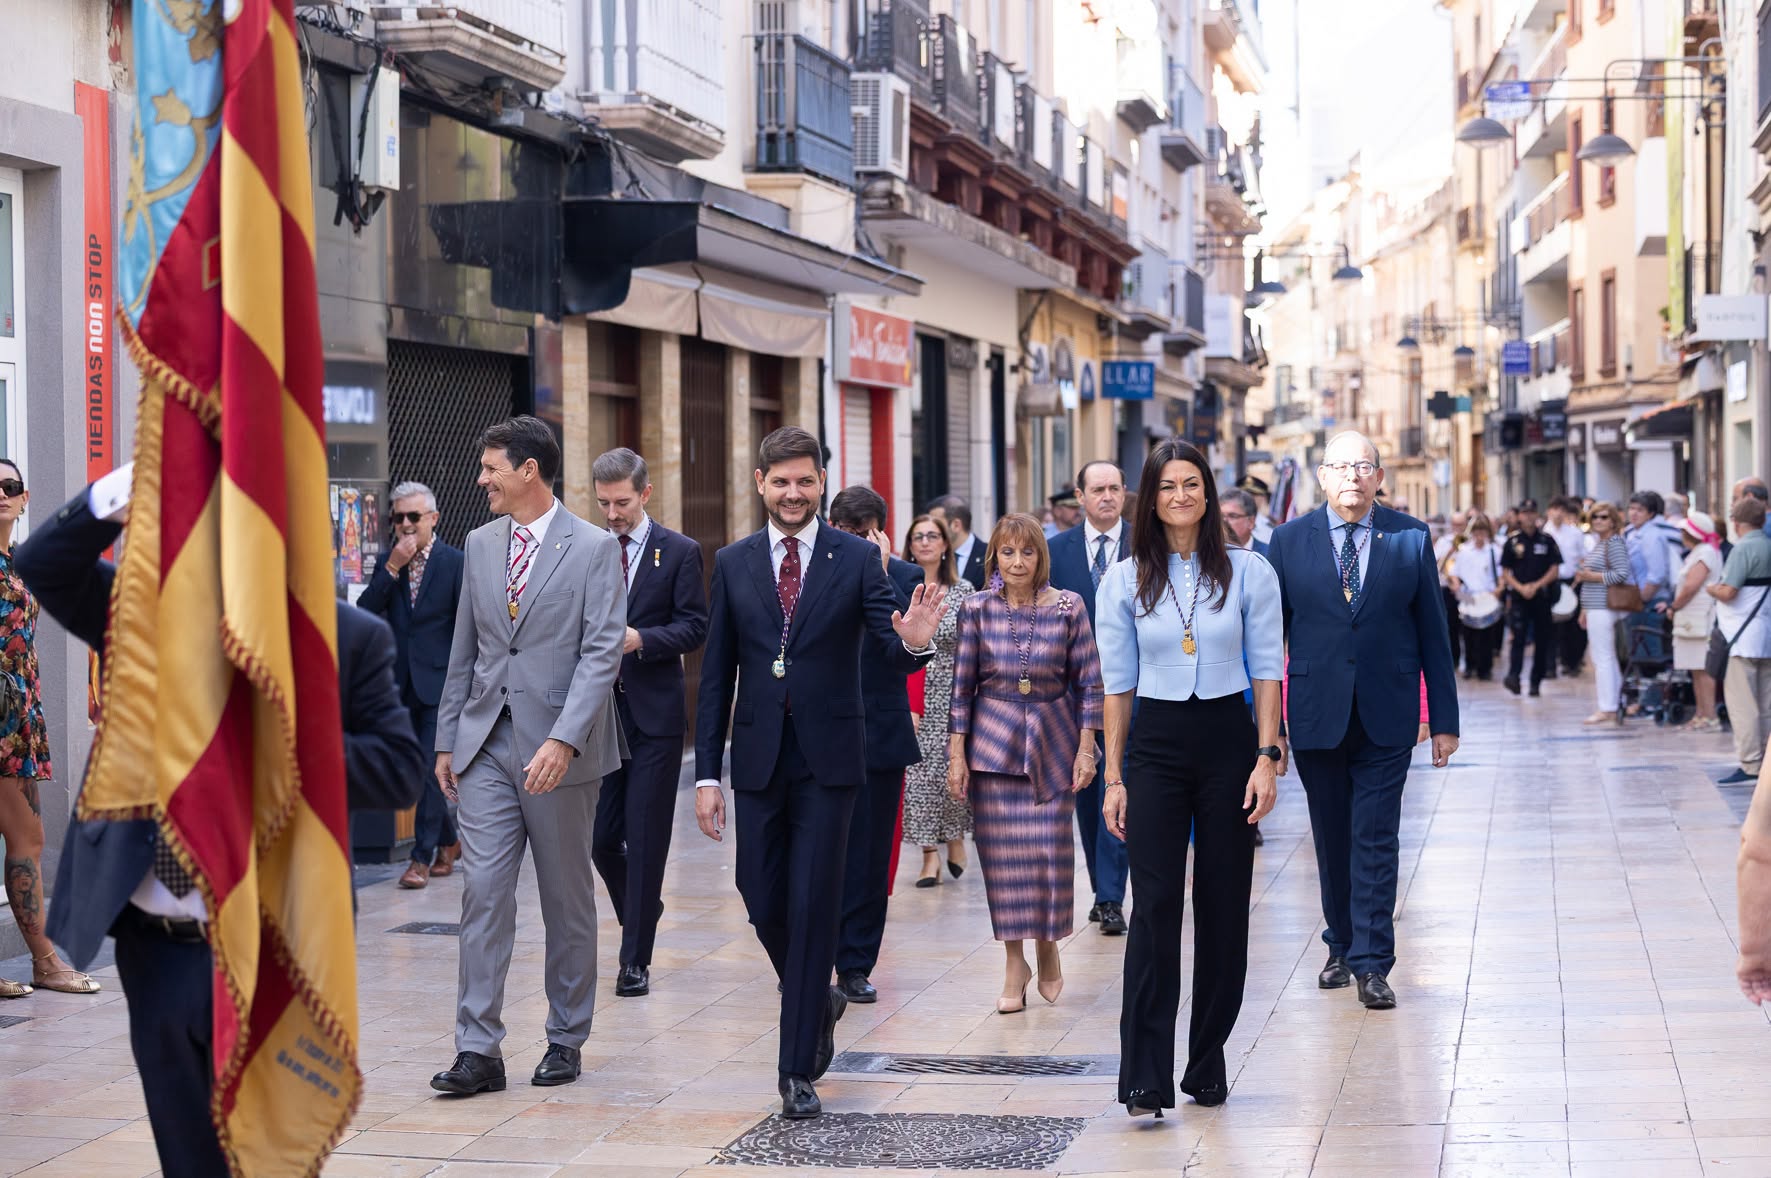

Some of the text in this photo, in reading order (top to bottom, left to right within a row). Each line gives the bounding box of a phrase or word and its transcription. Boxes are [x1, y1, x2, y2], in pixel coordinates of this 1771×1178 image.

[88, 233, 103, 299] STOP
[89, 355, 103, 462] TIENDAS
[1104, 366, 1151, 385] LLAR
